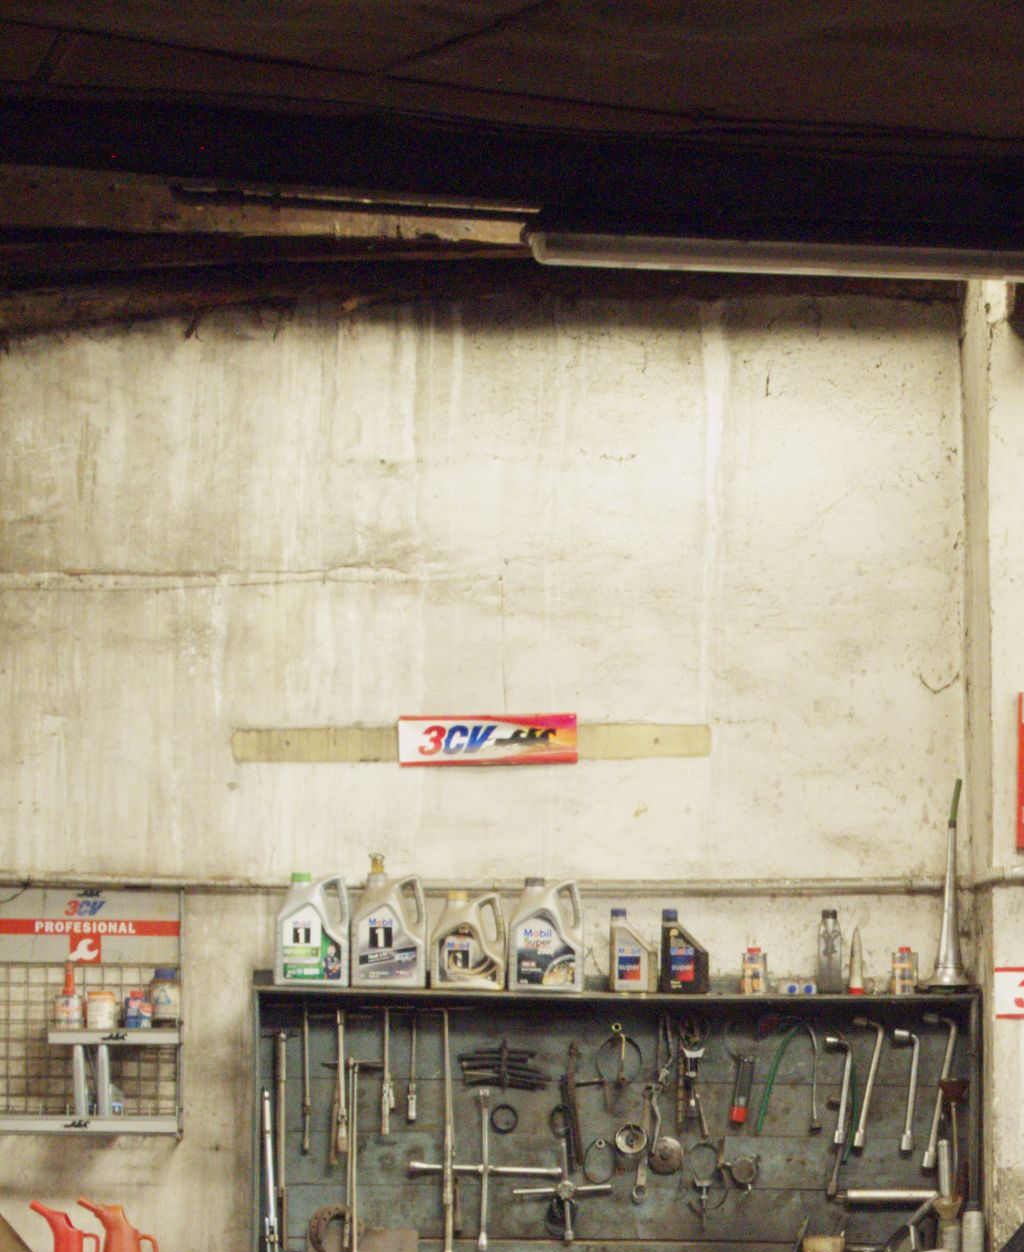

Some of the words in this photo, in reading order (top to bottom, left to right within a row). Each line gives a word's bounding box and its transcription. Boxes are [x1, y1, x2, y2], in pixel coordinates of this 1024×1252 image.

[418, 725, 499, 756] 3CV
[64, 899, 106, 916] 3CV
[34, 921, 136, 934] PROFESIONAL
[524, 929, 552, 938] Mobil
